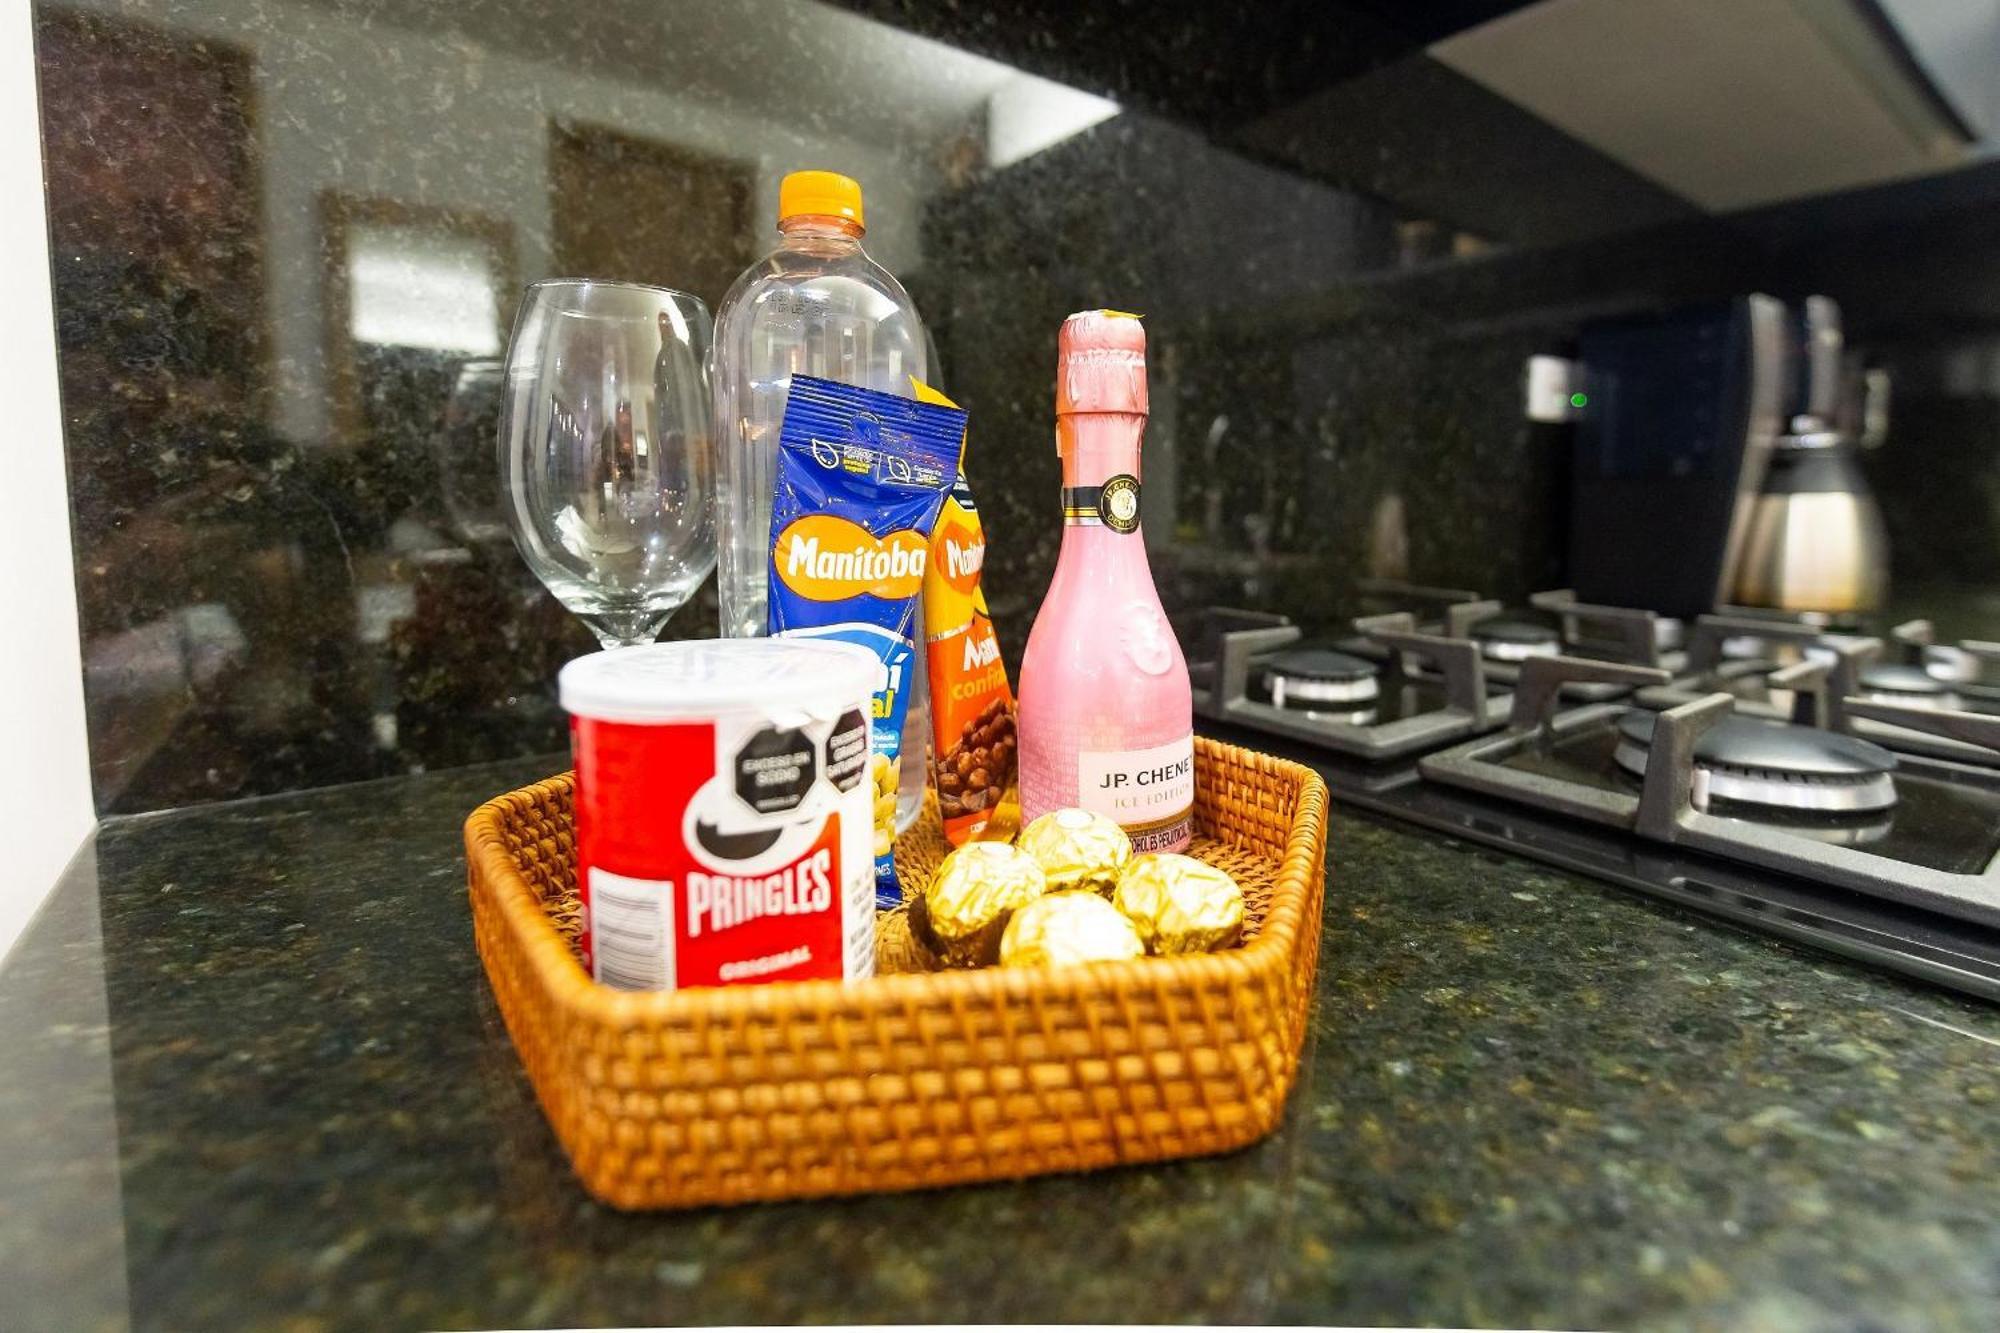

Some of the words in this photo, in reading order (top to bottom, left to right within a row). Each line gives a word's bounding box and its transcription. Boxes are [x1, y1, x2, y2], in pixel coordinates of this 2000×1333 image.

[787, 534, 927, 581] Manitoba
[1100, 773, 1129, 789] JP.
[687, 849, 832, 938] PRINGLES
